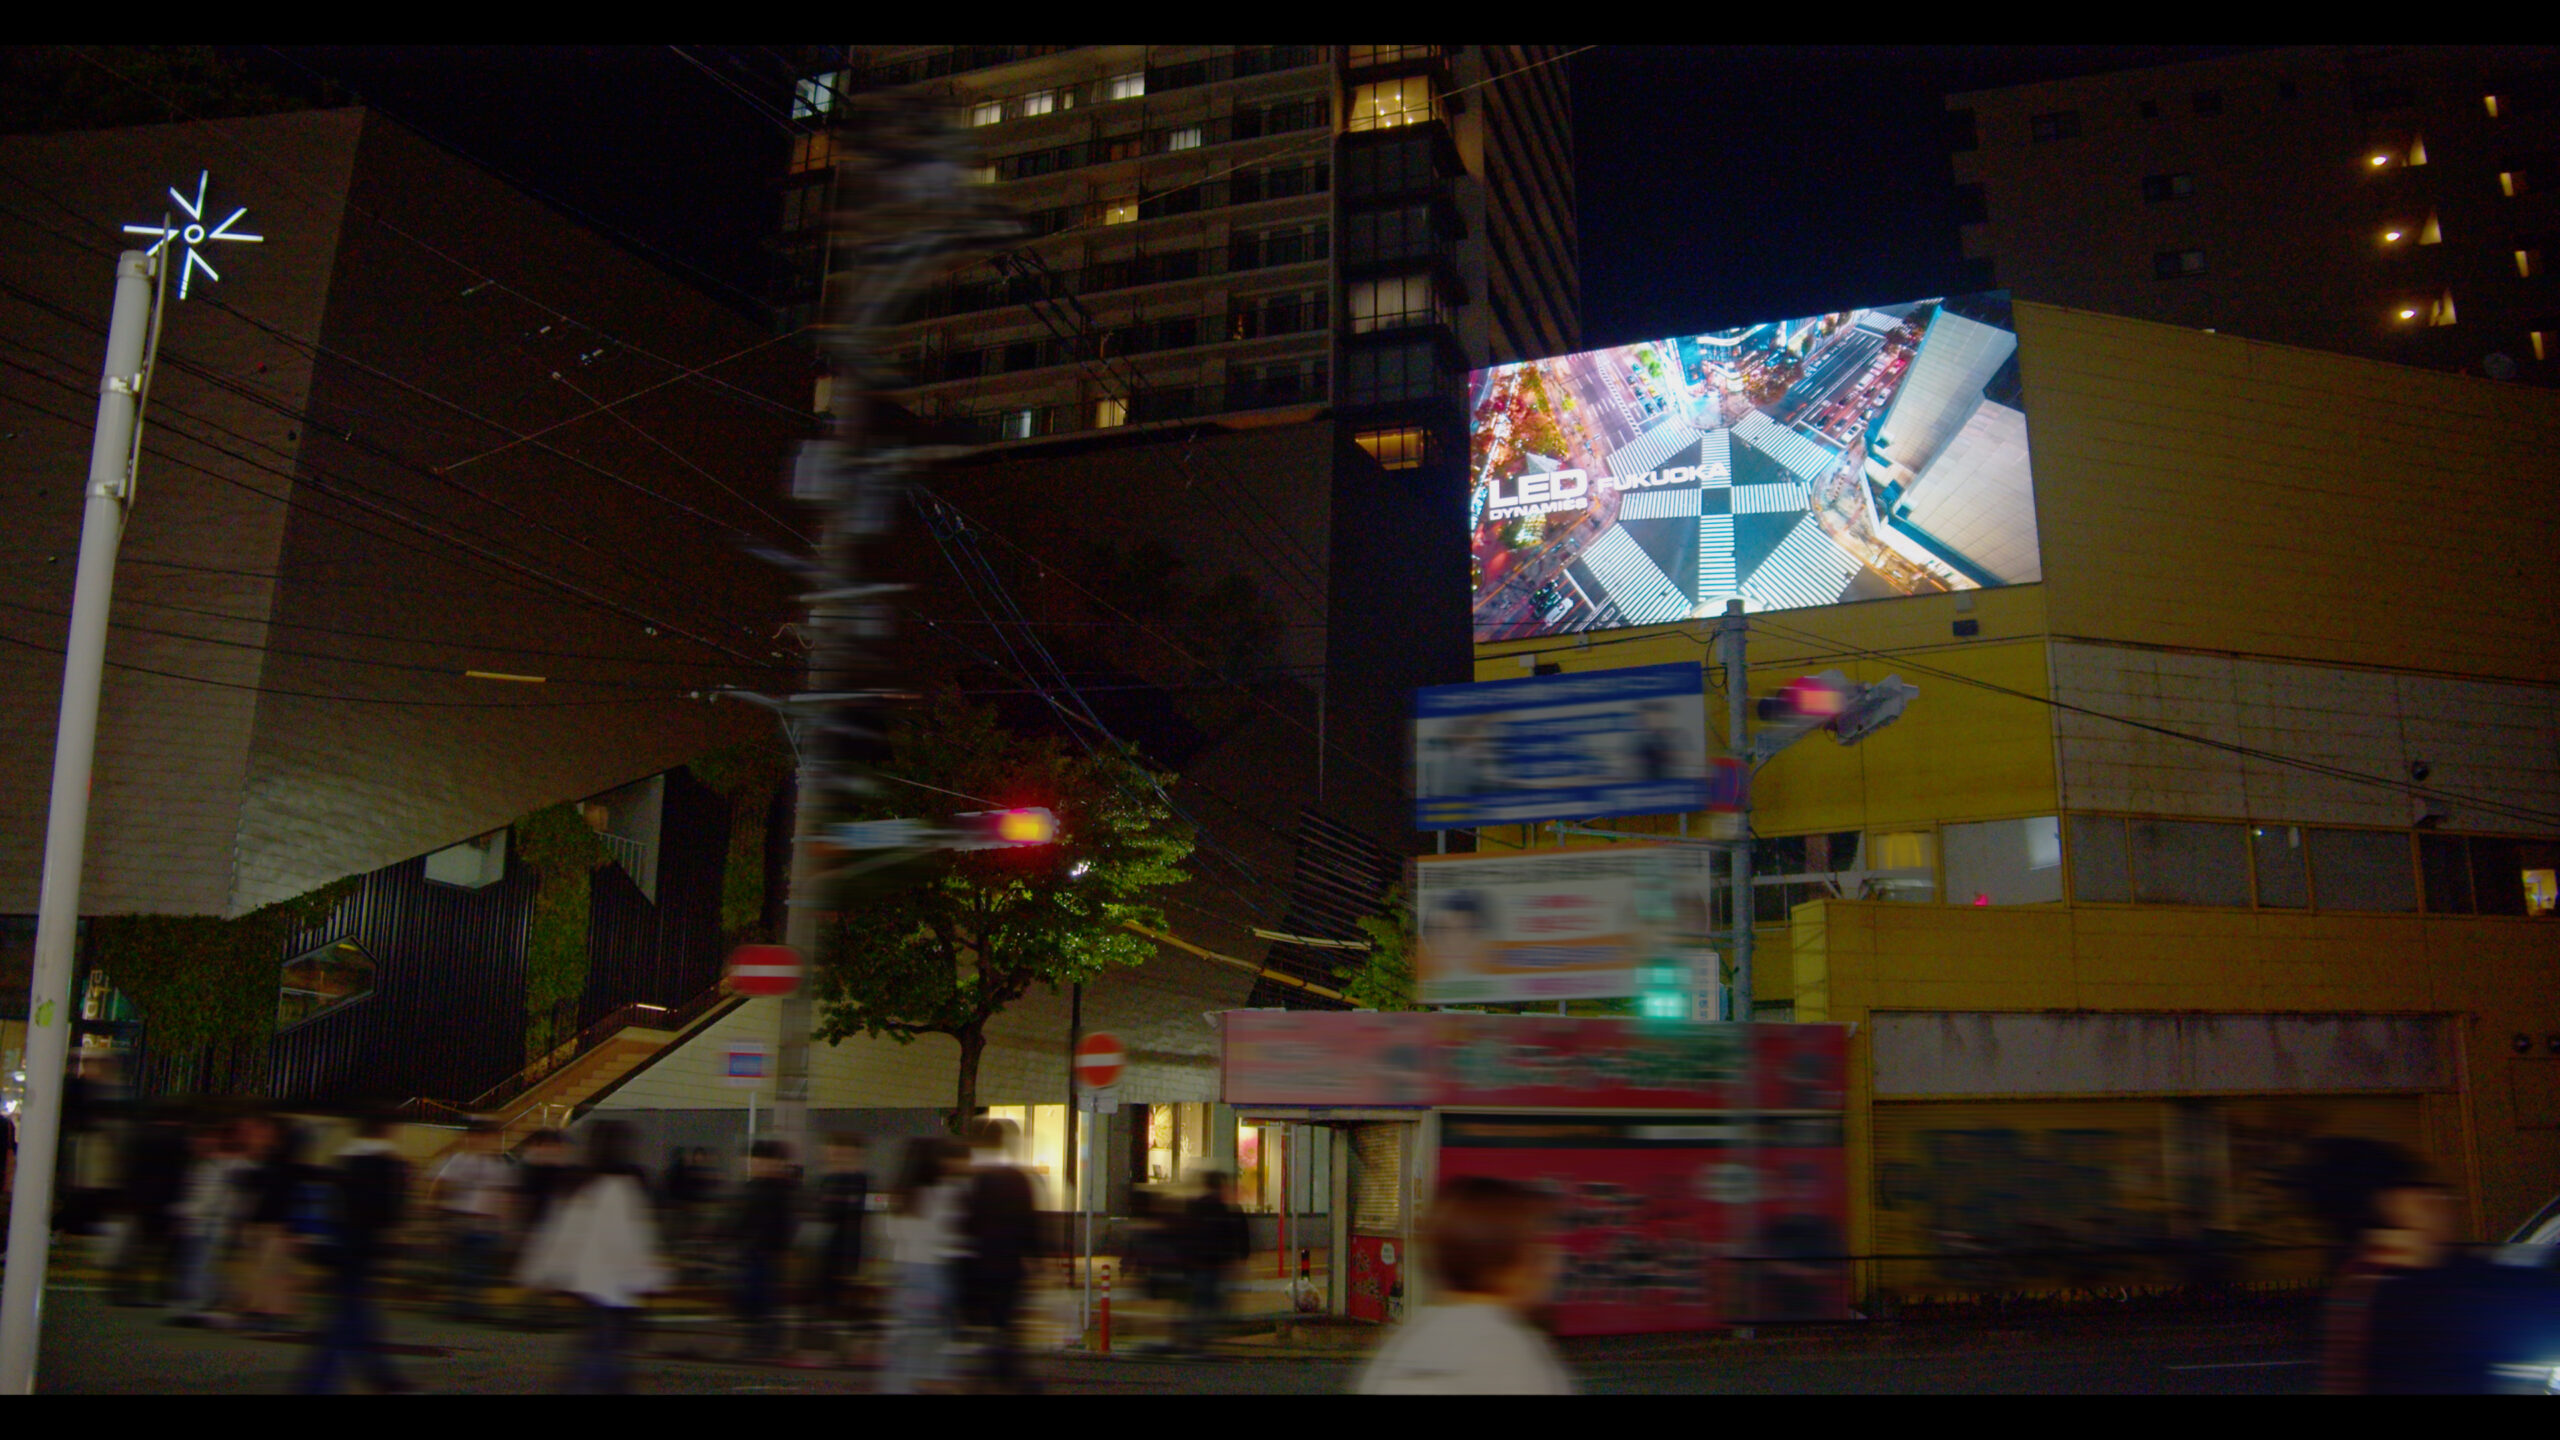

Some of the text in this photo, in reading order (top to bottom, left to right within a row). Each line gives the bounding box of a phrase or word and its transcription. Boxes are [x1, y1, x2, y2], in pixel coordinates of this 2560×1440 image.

[1489, 469, 1588, 508] LED
[1597, 463, 1730, 493] FUKUOKA
[1489, 497, 1588, 521] DYNAMICS
